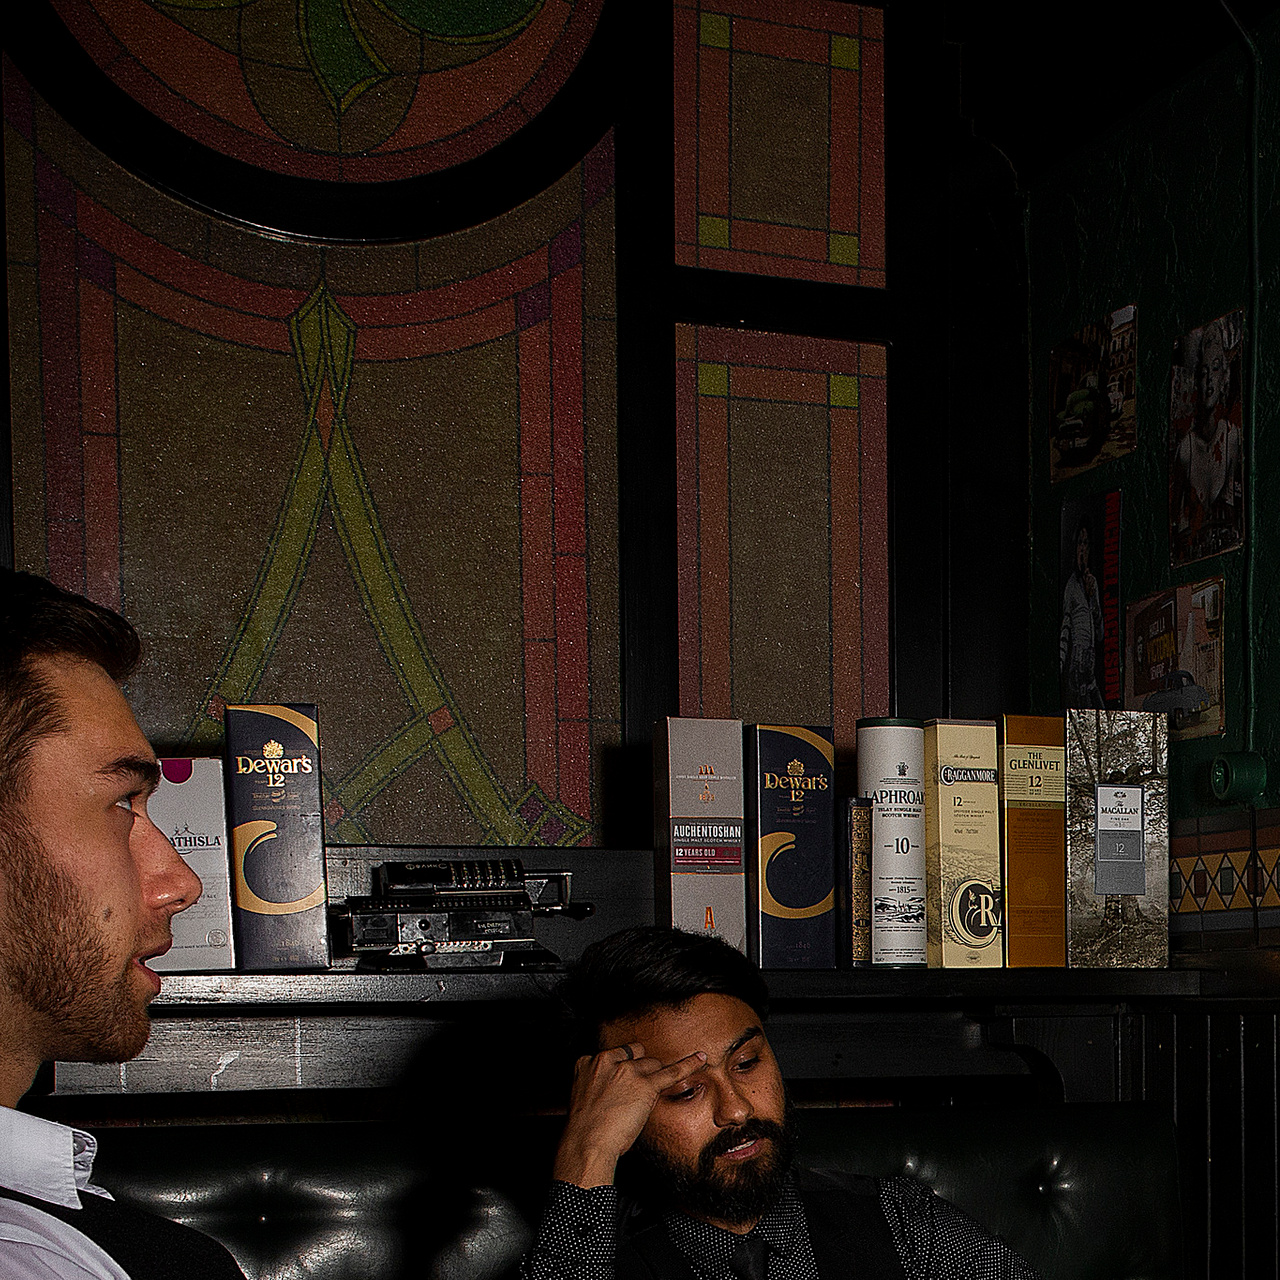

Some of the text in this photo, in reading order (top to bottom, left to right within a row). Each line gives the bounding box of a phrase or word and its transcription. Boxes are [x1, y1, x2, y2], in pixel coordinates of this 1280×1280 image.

[1103, 491, 1120, 701] MICHAEL JACKSON
[234, 754, 313, 774] Dewar's
[1009, 759, 1060, 771] GLENLIVET
[266, 774, 286, 787] 12
[763, 771, 828, 790] Dewar's
[941, 765, 996, 785] CRAGGANMORE
[1029, 775, 1043, 788] 12
[789, 790, 804, 802] 12
[953, 796, 963, 807] 12
[673, 825, 741, 838] AUCHENTOSHAN
[895, 837, 910, 854] 10
[1116, 843, 1125, 853] 12
[675, 848, 716, 857] 12 YEARS OLD
[897, 886, 911, 894] 1815
[704, 907, 715, 929] A
